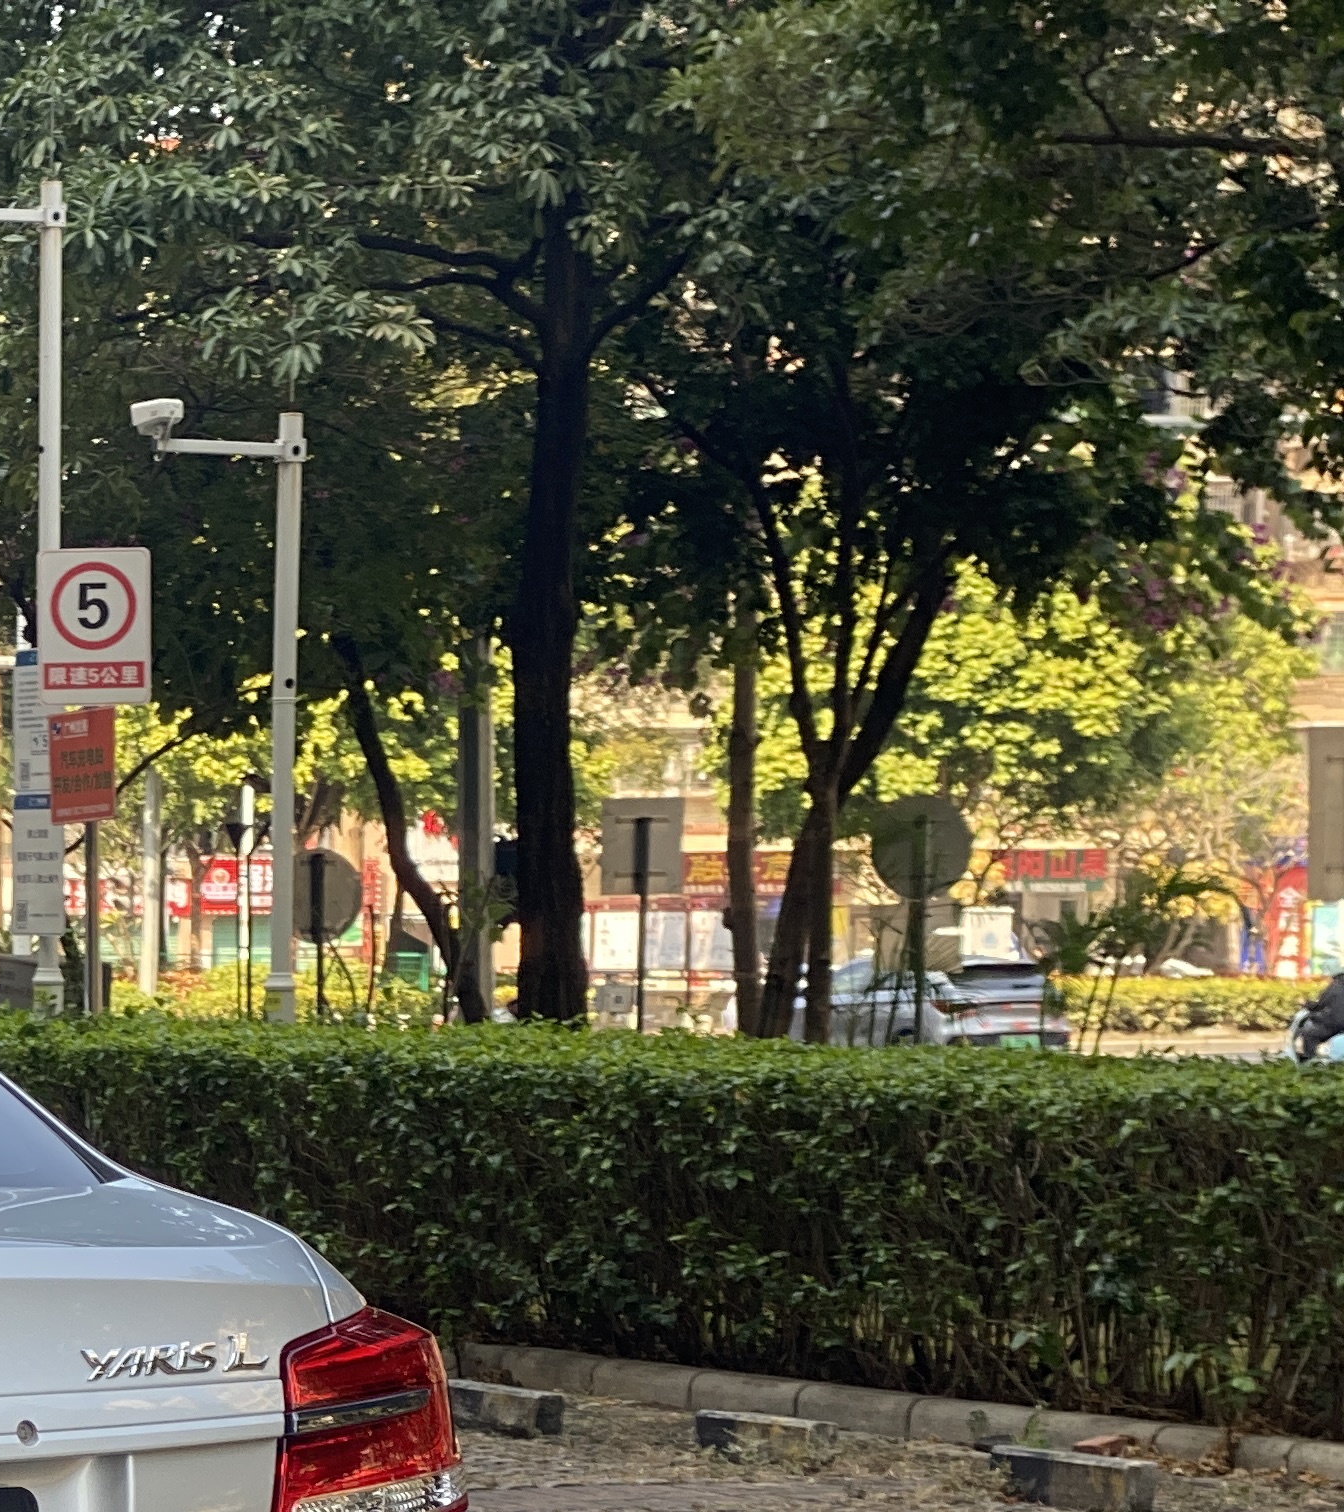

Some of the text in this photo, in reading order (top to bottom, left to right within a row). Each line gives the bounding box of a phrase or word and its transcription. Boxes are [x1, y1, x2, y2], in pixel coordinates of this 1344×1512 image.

[77, 582, 109, 629] 5
[48, 665, 139, 686] 限速5公里
[222, 1332, 269, 1373] L
